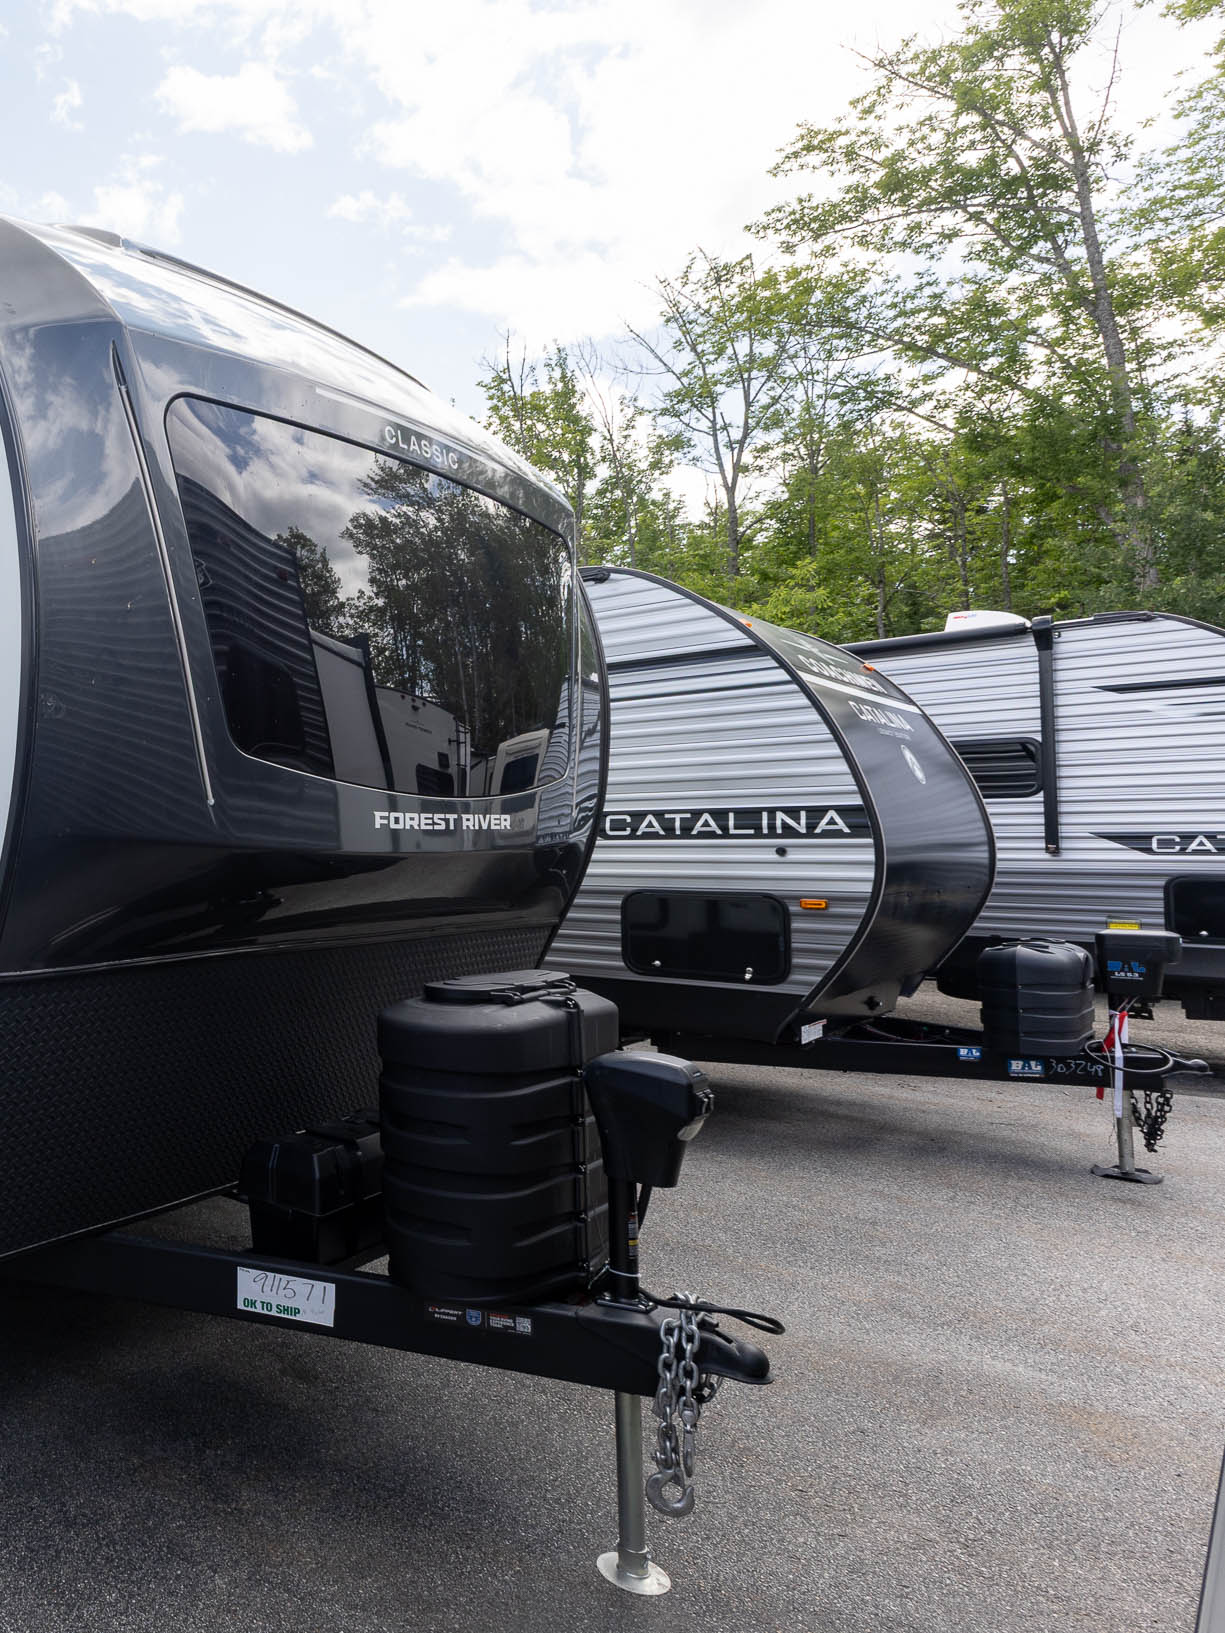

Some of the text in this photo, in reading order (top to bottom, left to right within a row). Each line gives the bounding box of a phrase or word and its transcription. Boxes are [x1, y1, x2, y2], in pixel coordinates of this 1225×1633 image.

[384, 425, 458, 470] CLASSIC
[847, 700, 915, 733] CATALINA
[373, 811, 511, 830] FOREST RIVER
[605, 809, 852, 836] CATALINA
[243, 1297, 257, 1310] OK
[260, 1301, 273, 1313] TO
[276, 1303, 301, 1317] SHIP
